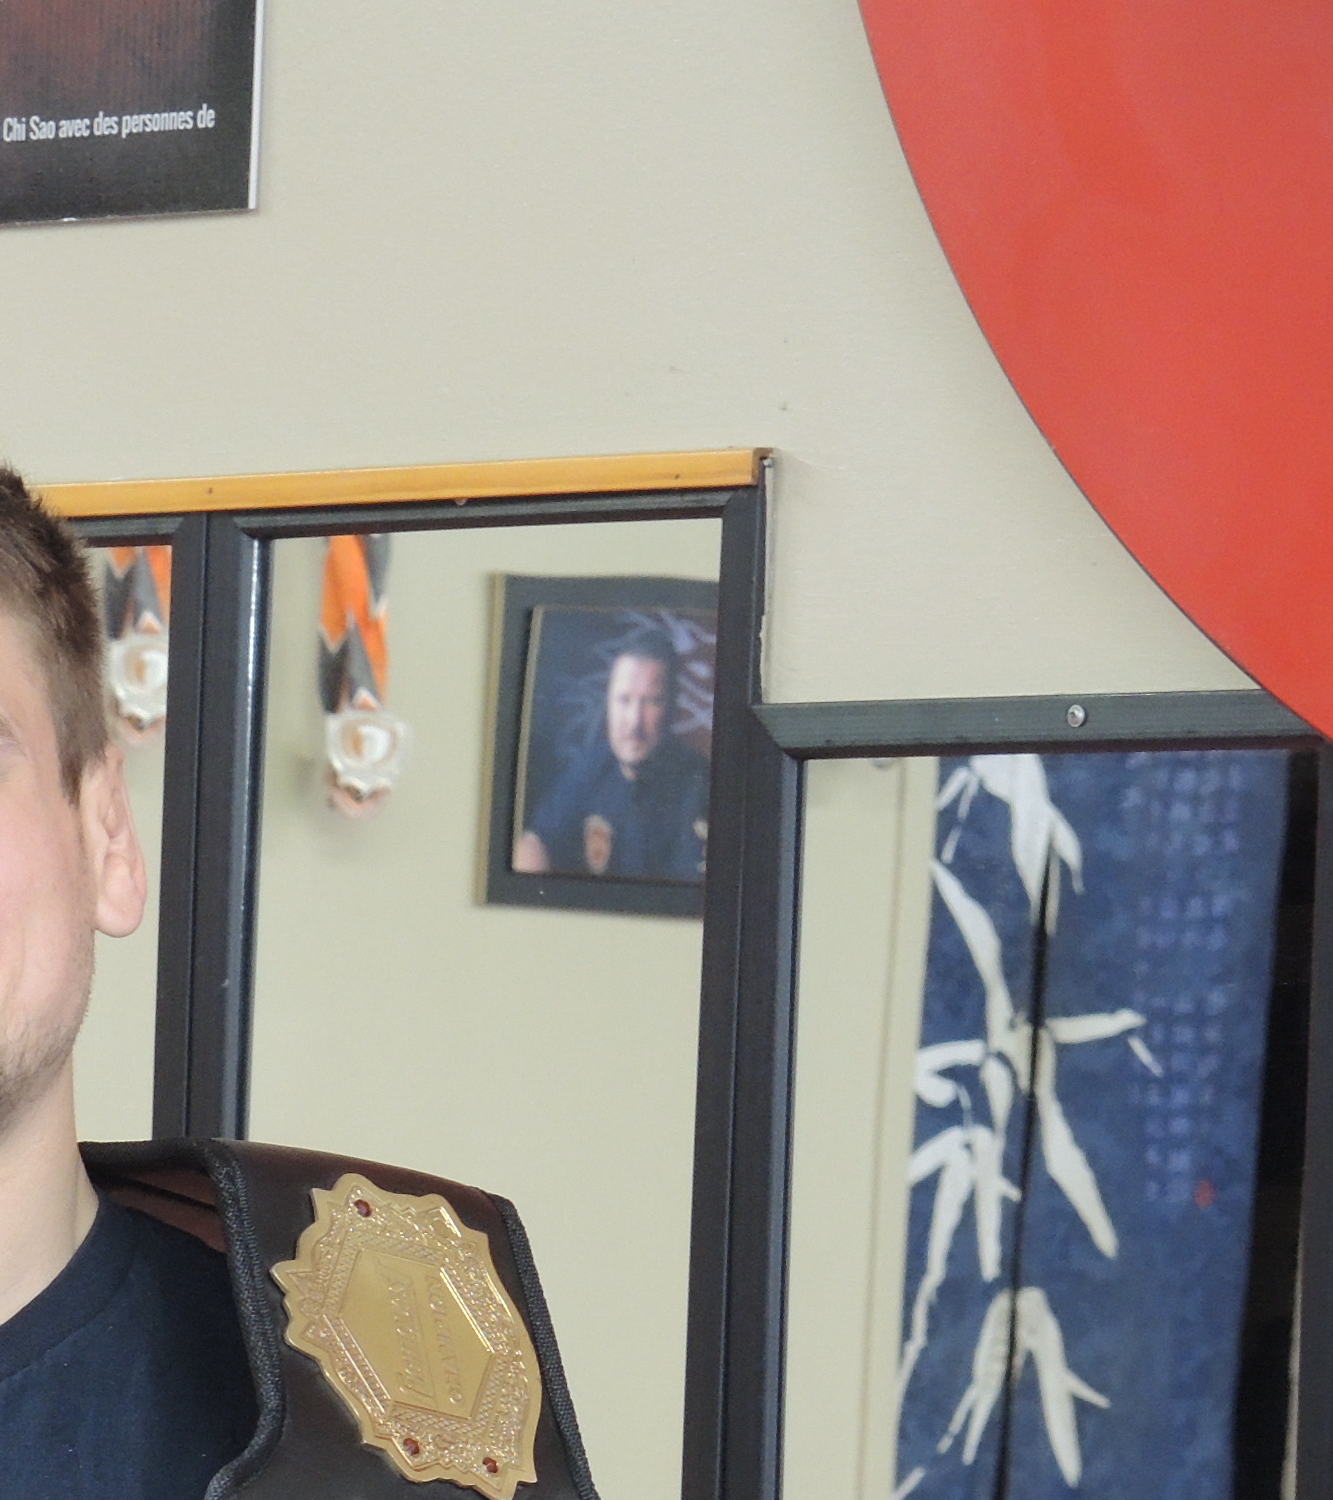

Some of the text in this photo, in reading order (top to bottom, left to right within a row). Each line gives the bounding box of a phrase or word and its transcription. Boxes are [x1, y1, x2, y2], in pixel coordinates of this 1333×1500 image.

[3, 117, 26, 142] Chi
[29, 115, 56, 140] Sao
[58, 117, 90, 138] avec
[93, 111, 119, 136] des
[122, 110, 194, 139] personnes
[196, 103, 215, 129] de
